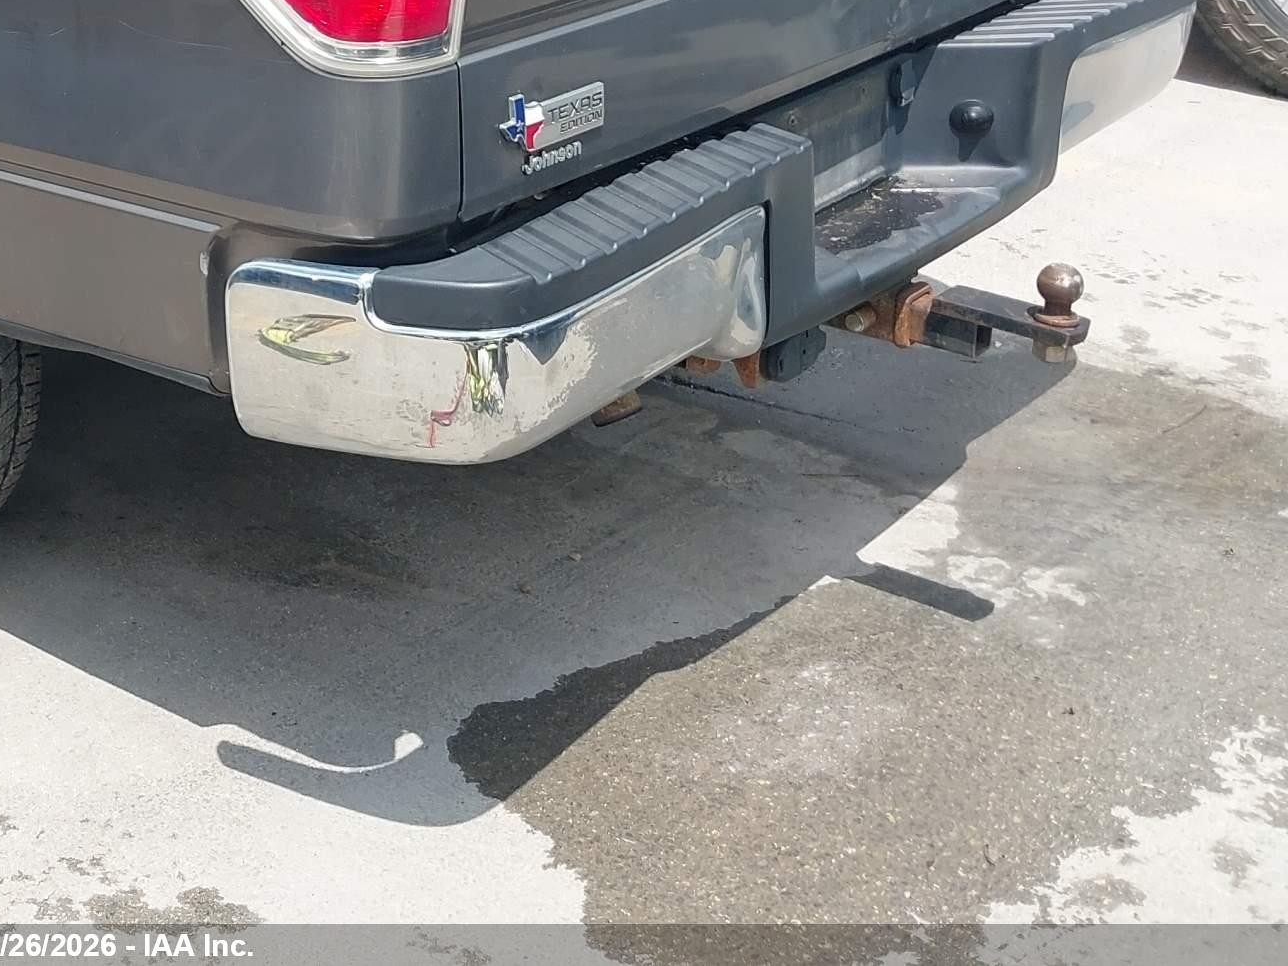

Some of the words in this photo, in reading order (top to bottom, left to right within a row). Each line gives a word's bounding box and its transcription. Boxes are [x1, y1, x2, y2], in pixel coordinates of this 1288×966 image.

[547, 91, 603, 123] TEXAS
[559, 109, 603, 133] EDITION
[521, 141, 582, 175] Johnson
